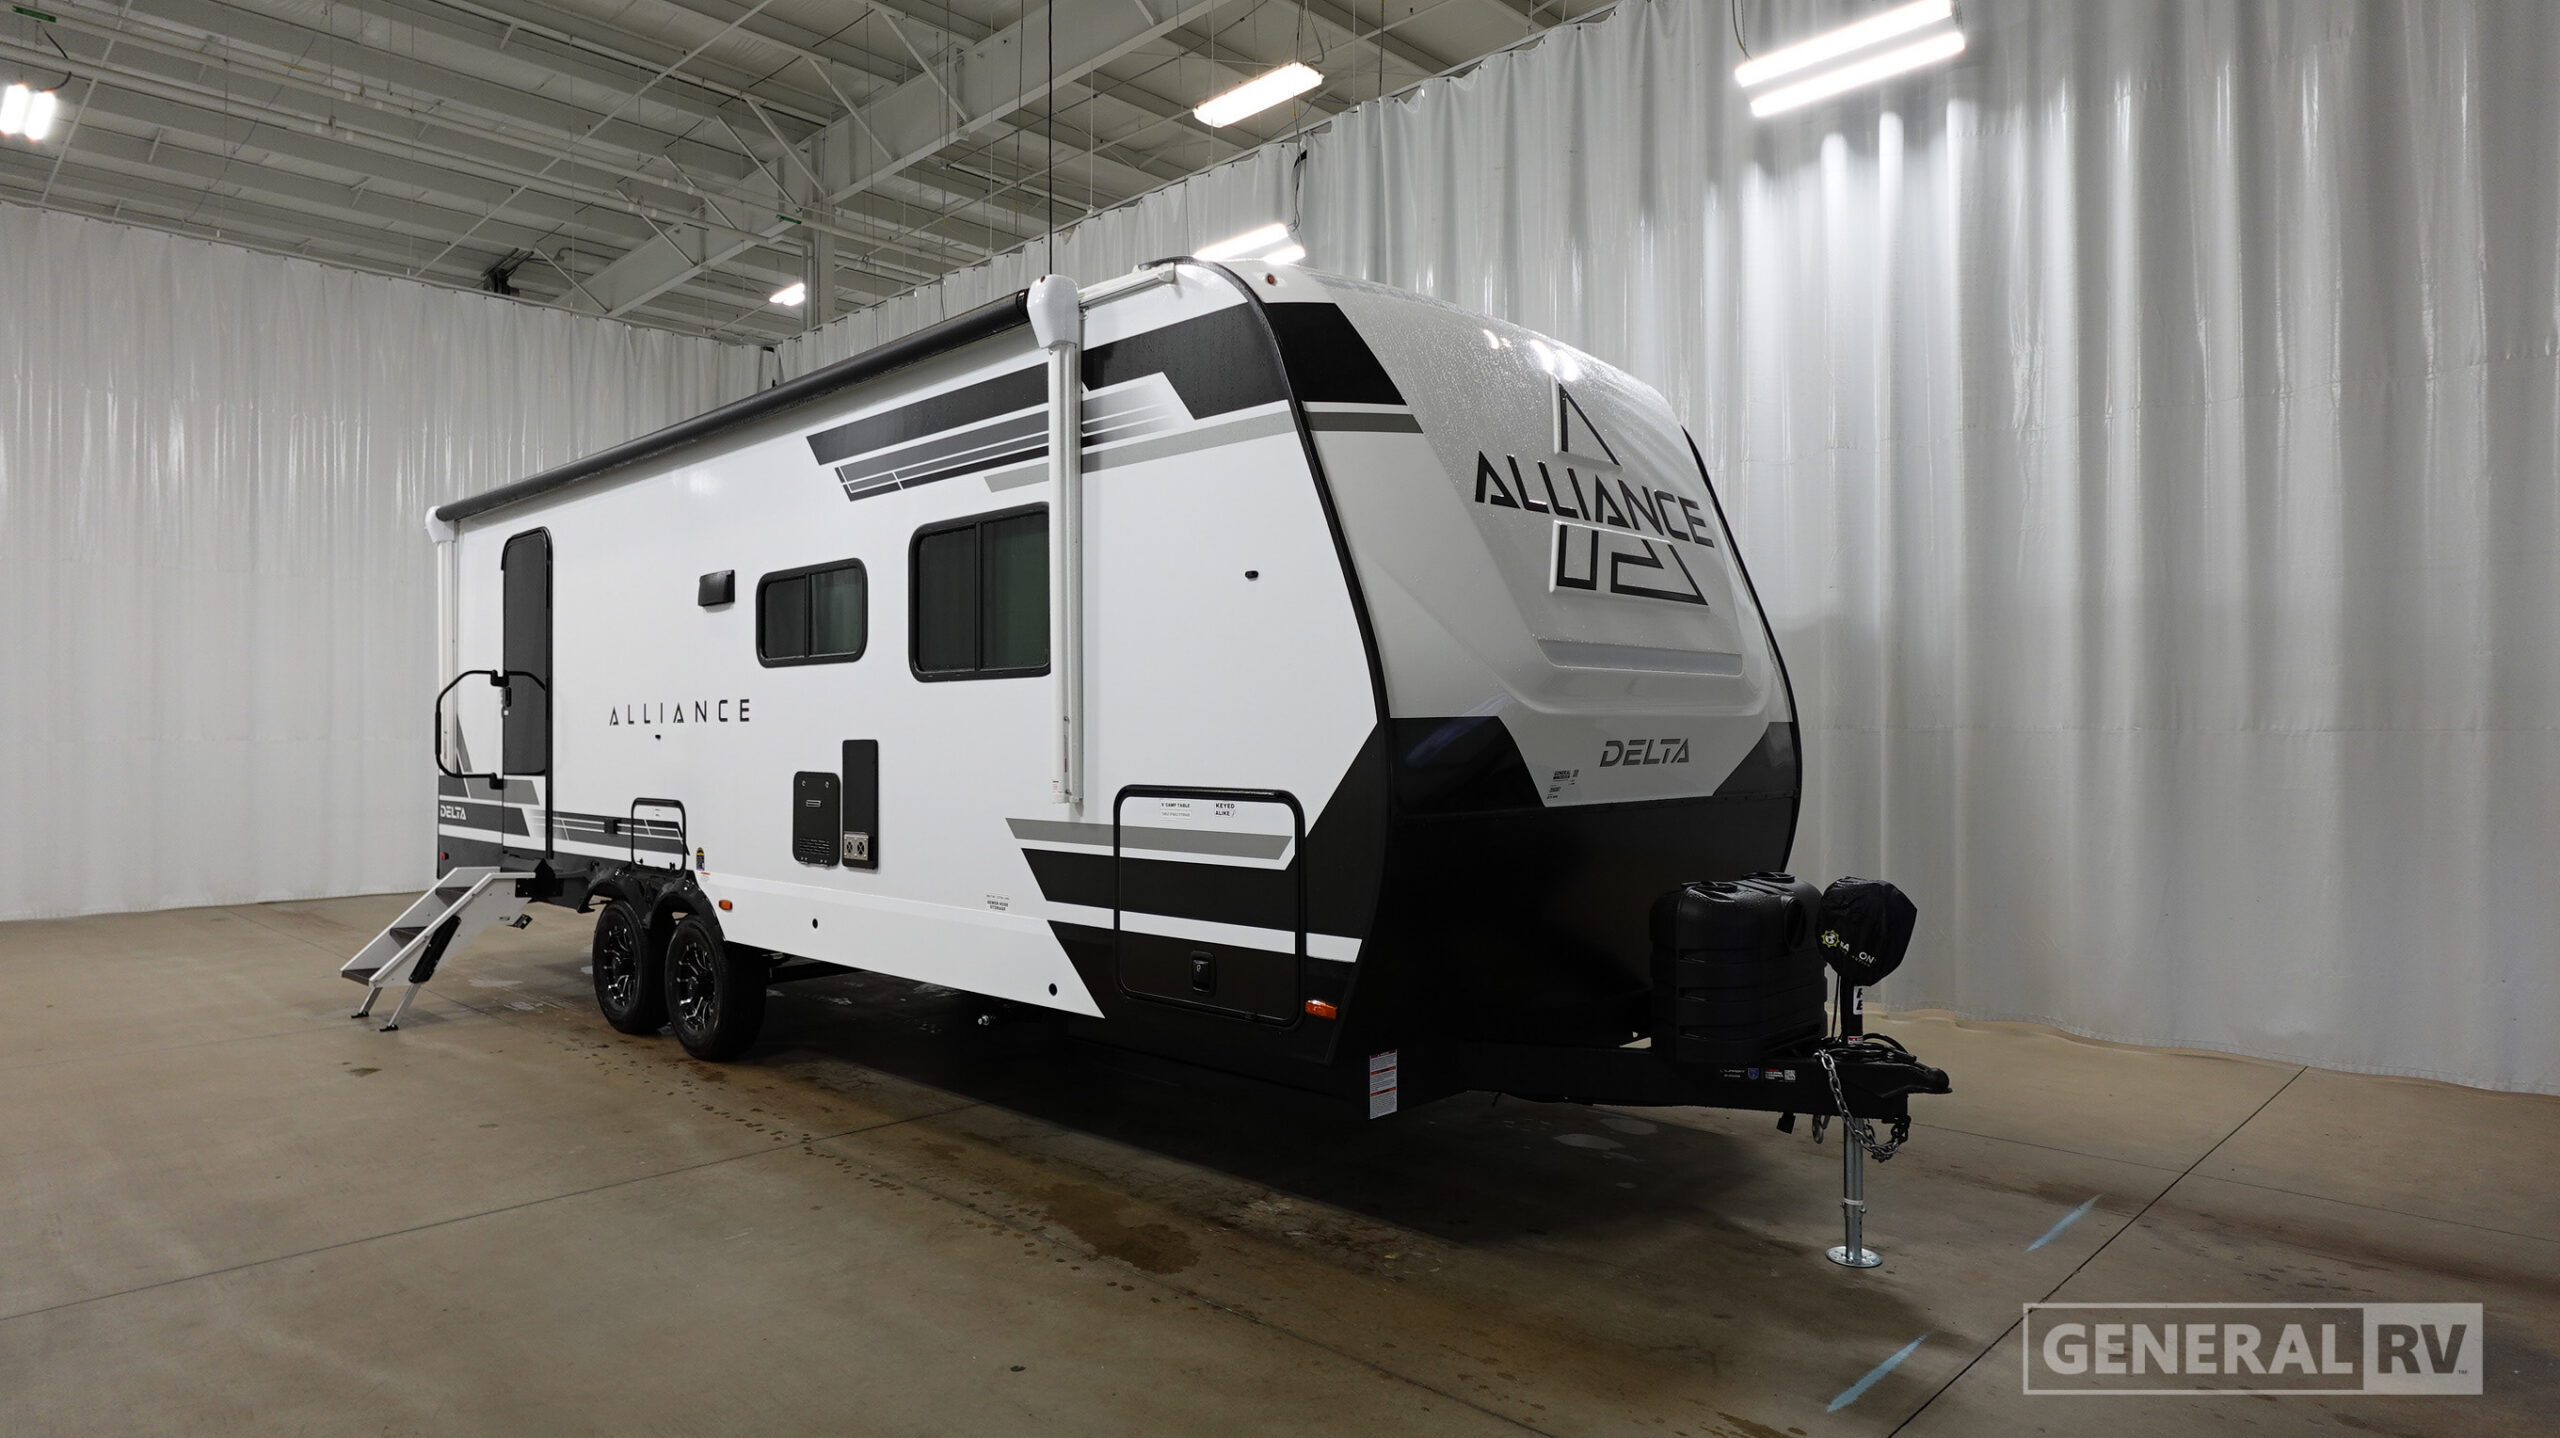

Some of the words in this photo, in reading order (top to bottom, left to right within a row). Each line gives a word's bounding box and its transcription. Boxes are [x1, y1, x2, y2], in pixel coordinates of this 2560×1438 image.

[1475, 451, 1714, 548] ALLIANCE
[609, 699, 750, 726] ALLIANCE
[1600, 738, 1689, 767] DELTA
[440, 805, 467, 820] DELTA
